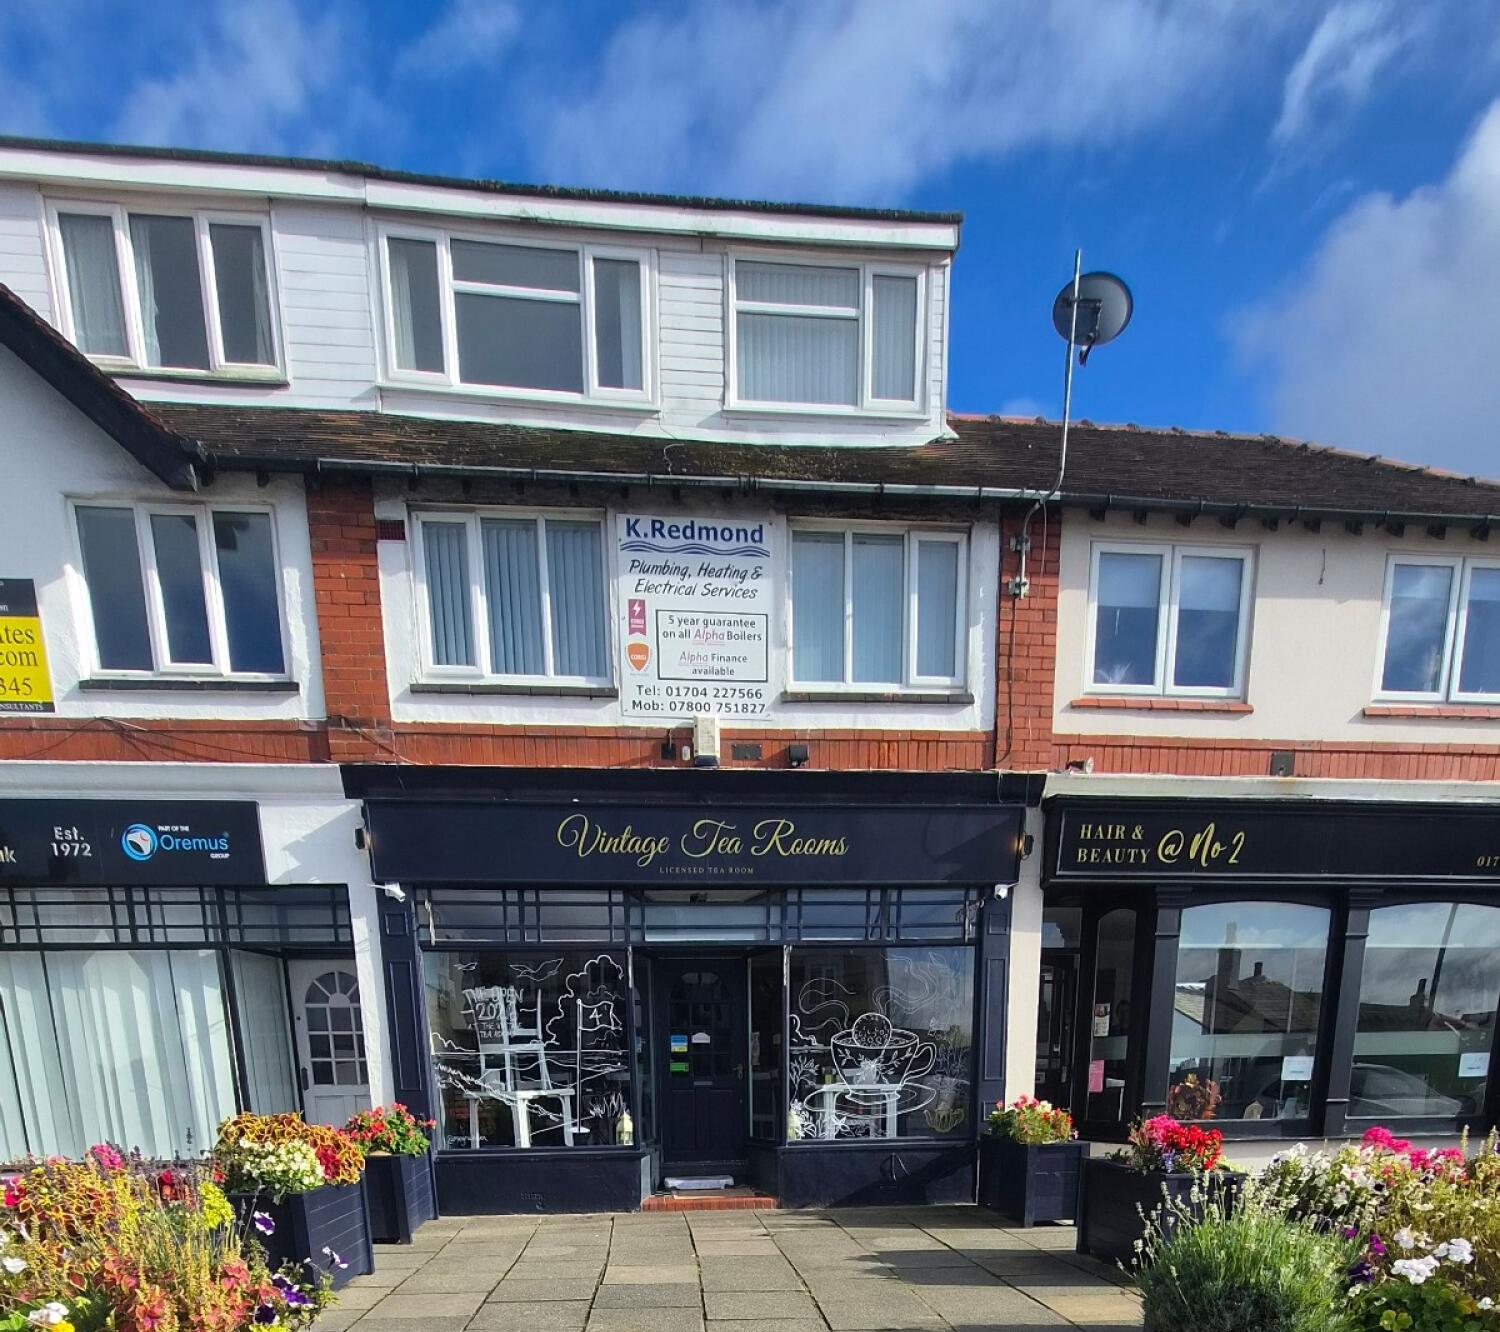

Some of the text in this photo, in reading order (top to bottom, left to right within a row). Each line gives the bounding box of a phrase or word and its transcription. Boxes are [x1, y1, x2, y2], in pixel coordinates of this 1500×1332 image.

[625, 518, 764, 544] K.Redmond
[629, 559, 763, 584] Plumbing, Heating &
[635, 578, 758, 599] Electrical Services
[668, 615, 756, 629] 5 year guarantee
[662, 629, 762, 643] on all Alpha Boilers
[679, 651, 748, 664] Alpha Finance
[692, 665, 735, 676] available
[636, 684, 762, 700] Tel: 01704 227566
[632, 700, 766, 714] Mob: 07800 751827
[53, 826, 85, 840] Est.
[1079, 824, 1145, 840] HAIR &
[160, 834, 229, 850] Oremus
[556, 813, 849, 867] Vintage Tea Rooms
[50, 842, 92, 857] 1972
[1077, 848, 1151, 864] BEAUTY
[659, 866, 754, 874] LICENSED TEA ROOM
